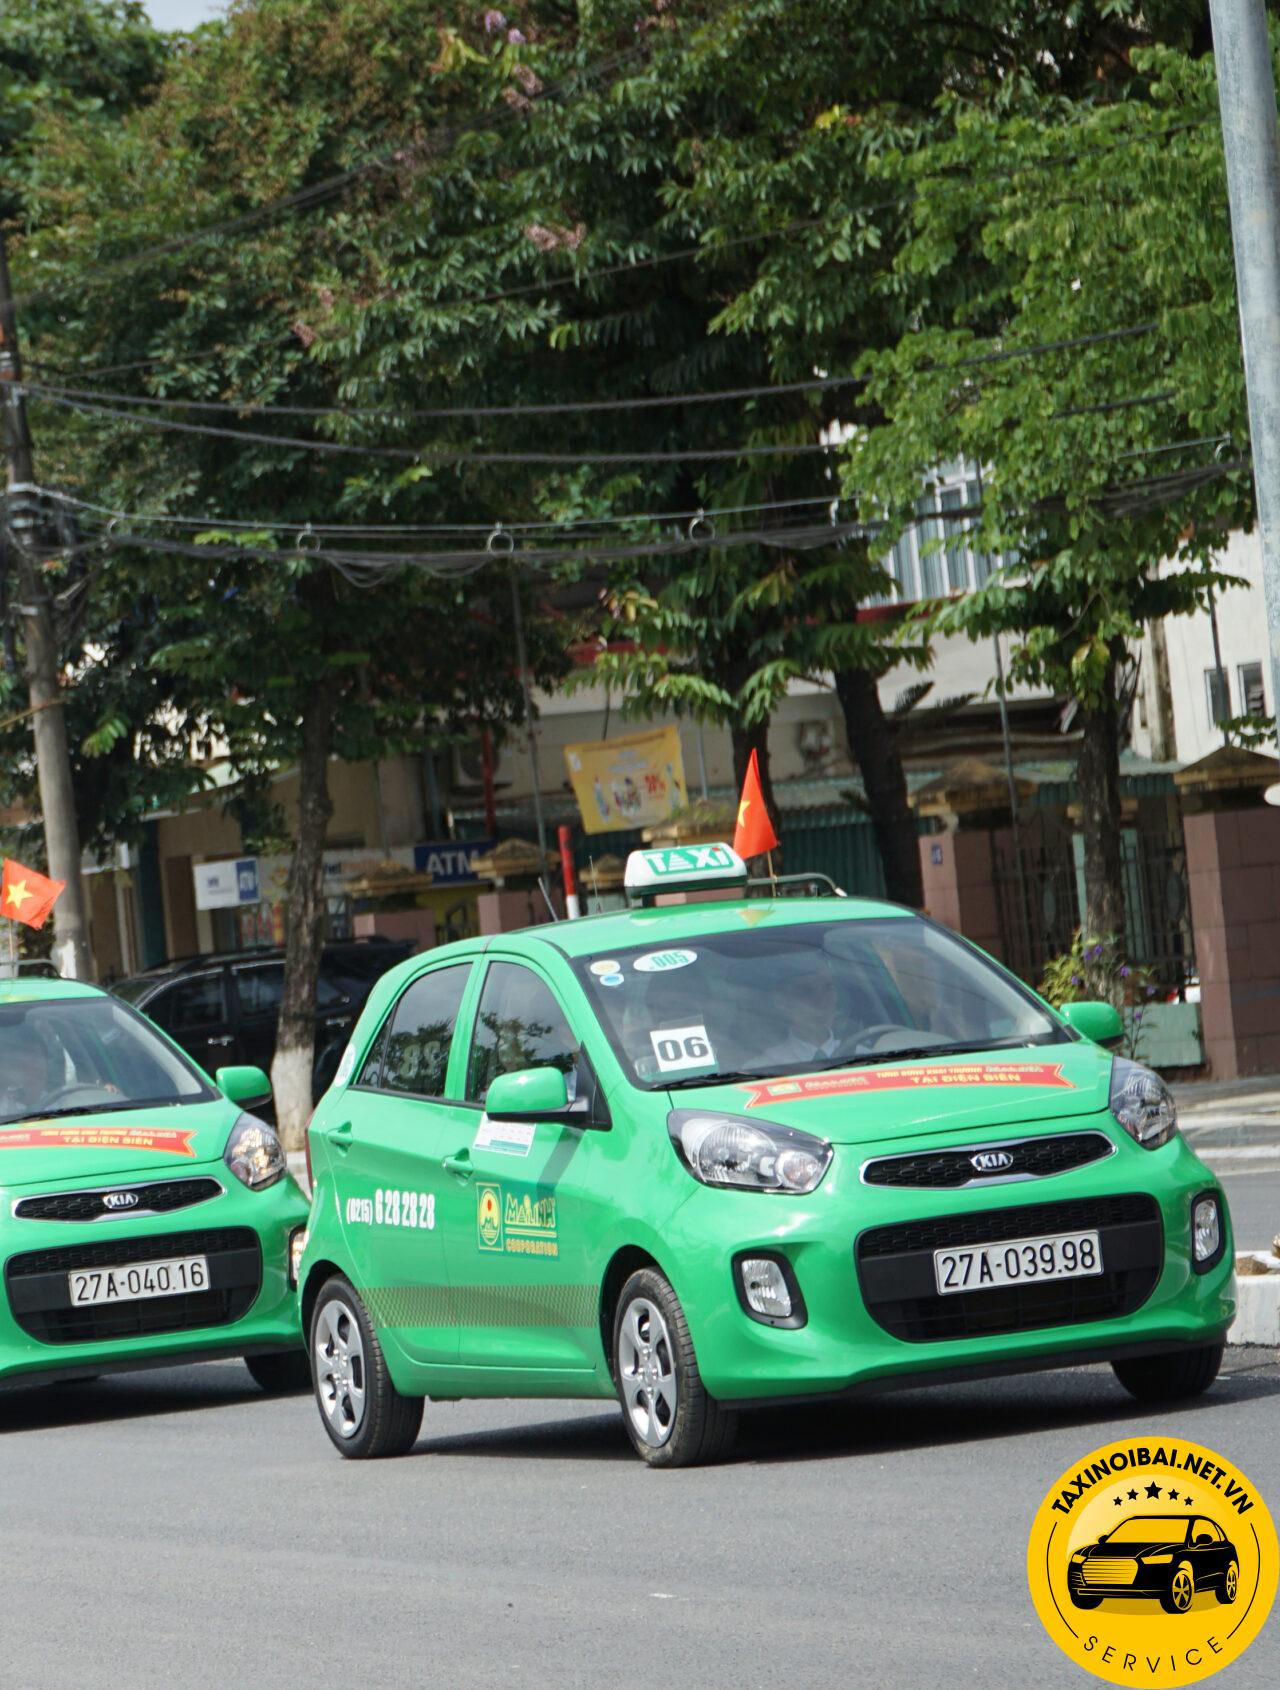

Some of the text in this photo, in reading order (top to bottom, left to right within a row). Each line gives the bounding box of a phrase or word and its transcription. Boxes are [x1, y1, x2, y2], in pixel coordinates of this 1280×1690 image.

[426, 850, 480, 876] ATM
[657, 1036, 709, 1062] 06
[977, 1153, 1009, 1169] KIA
[109, 1193, 135, 1207] KIA
[346, 1197, 373, 1226] (0215)
[941, 1238, 1096, 1288] 27A-039.98
[75, 1262, 204, 1302] 27A-040.16
